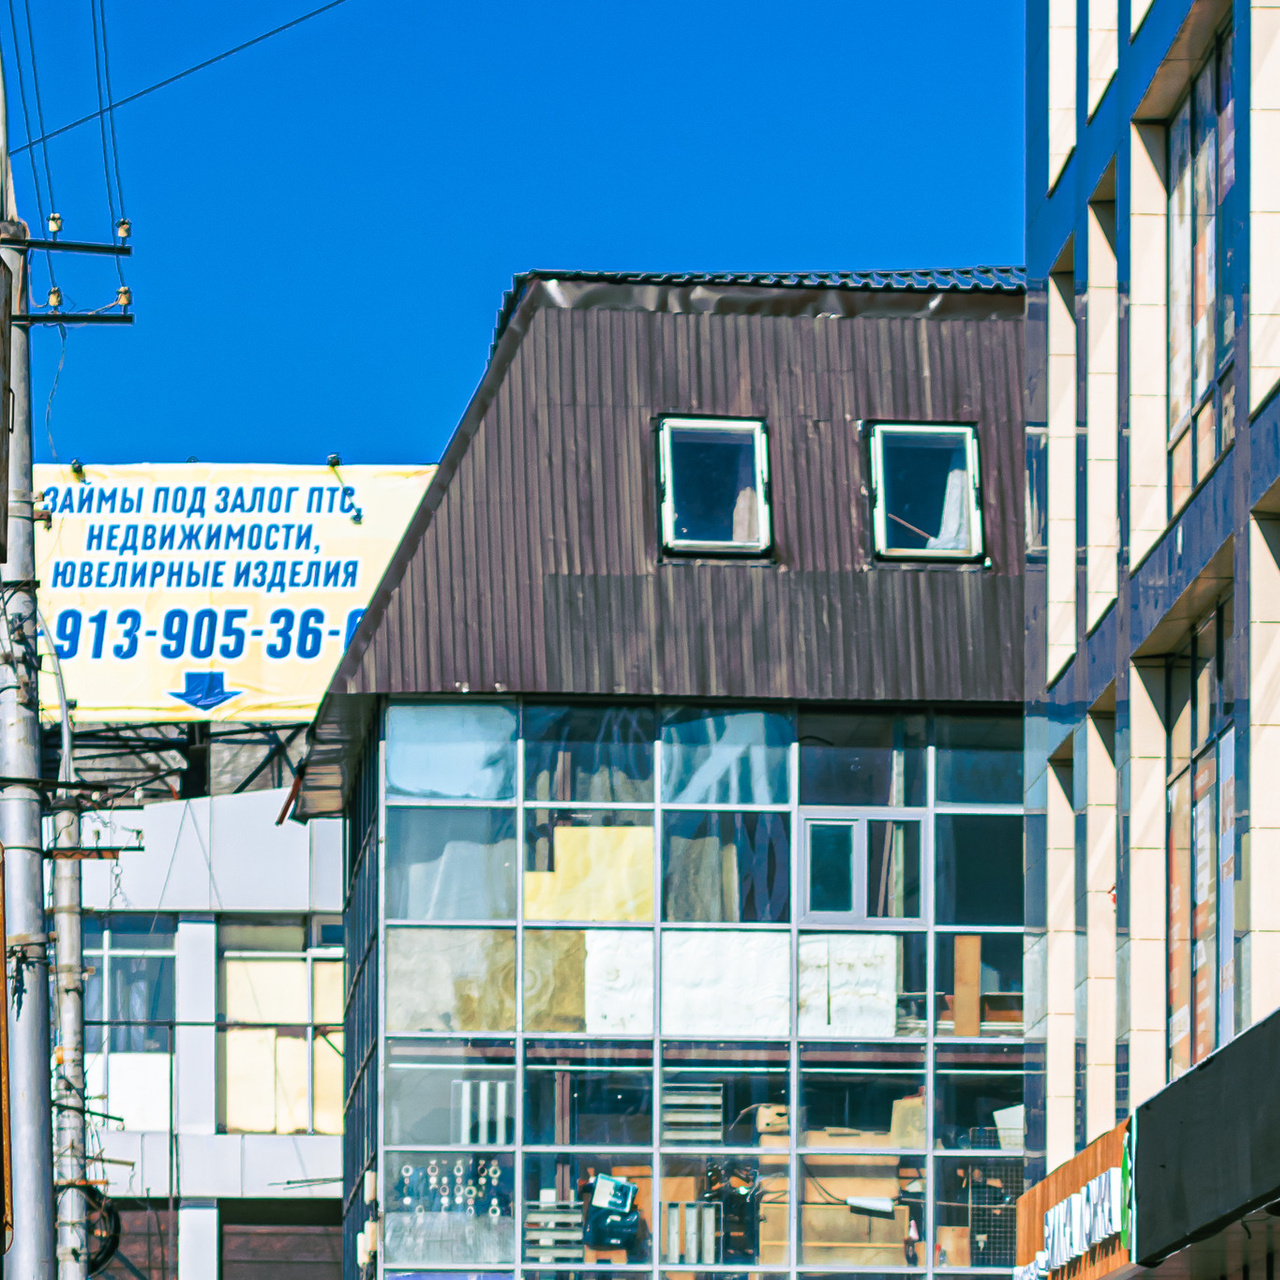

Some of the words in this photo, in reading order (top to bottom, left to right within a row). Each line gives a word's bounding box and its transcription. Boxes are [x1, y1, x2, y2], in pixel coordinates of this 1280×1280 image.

[43, 482, 145, 513] ЗАЙМЫ
[152, 486, 207, 518] ПОД
[215, 486, 299, 513] ЗАЛОГ
[86, 523, 321, 556] НЕДВИЖИМОСТИ,
[51, 561, 227, 588] ЮВЕЛИРНЫЕ
[233, 560, 359, 593] ИЗДЕЛИЯ
